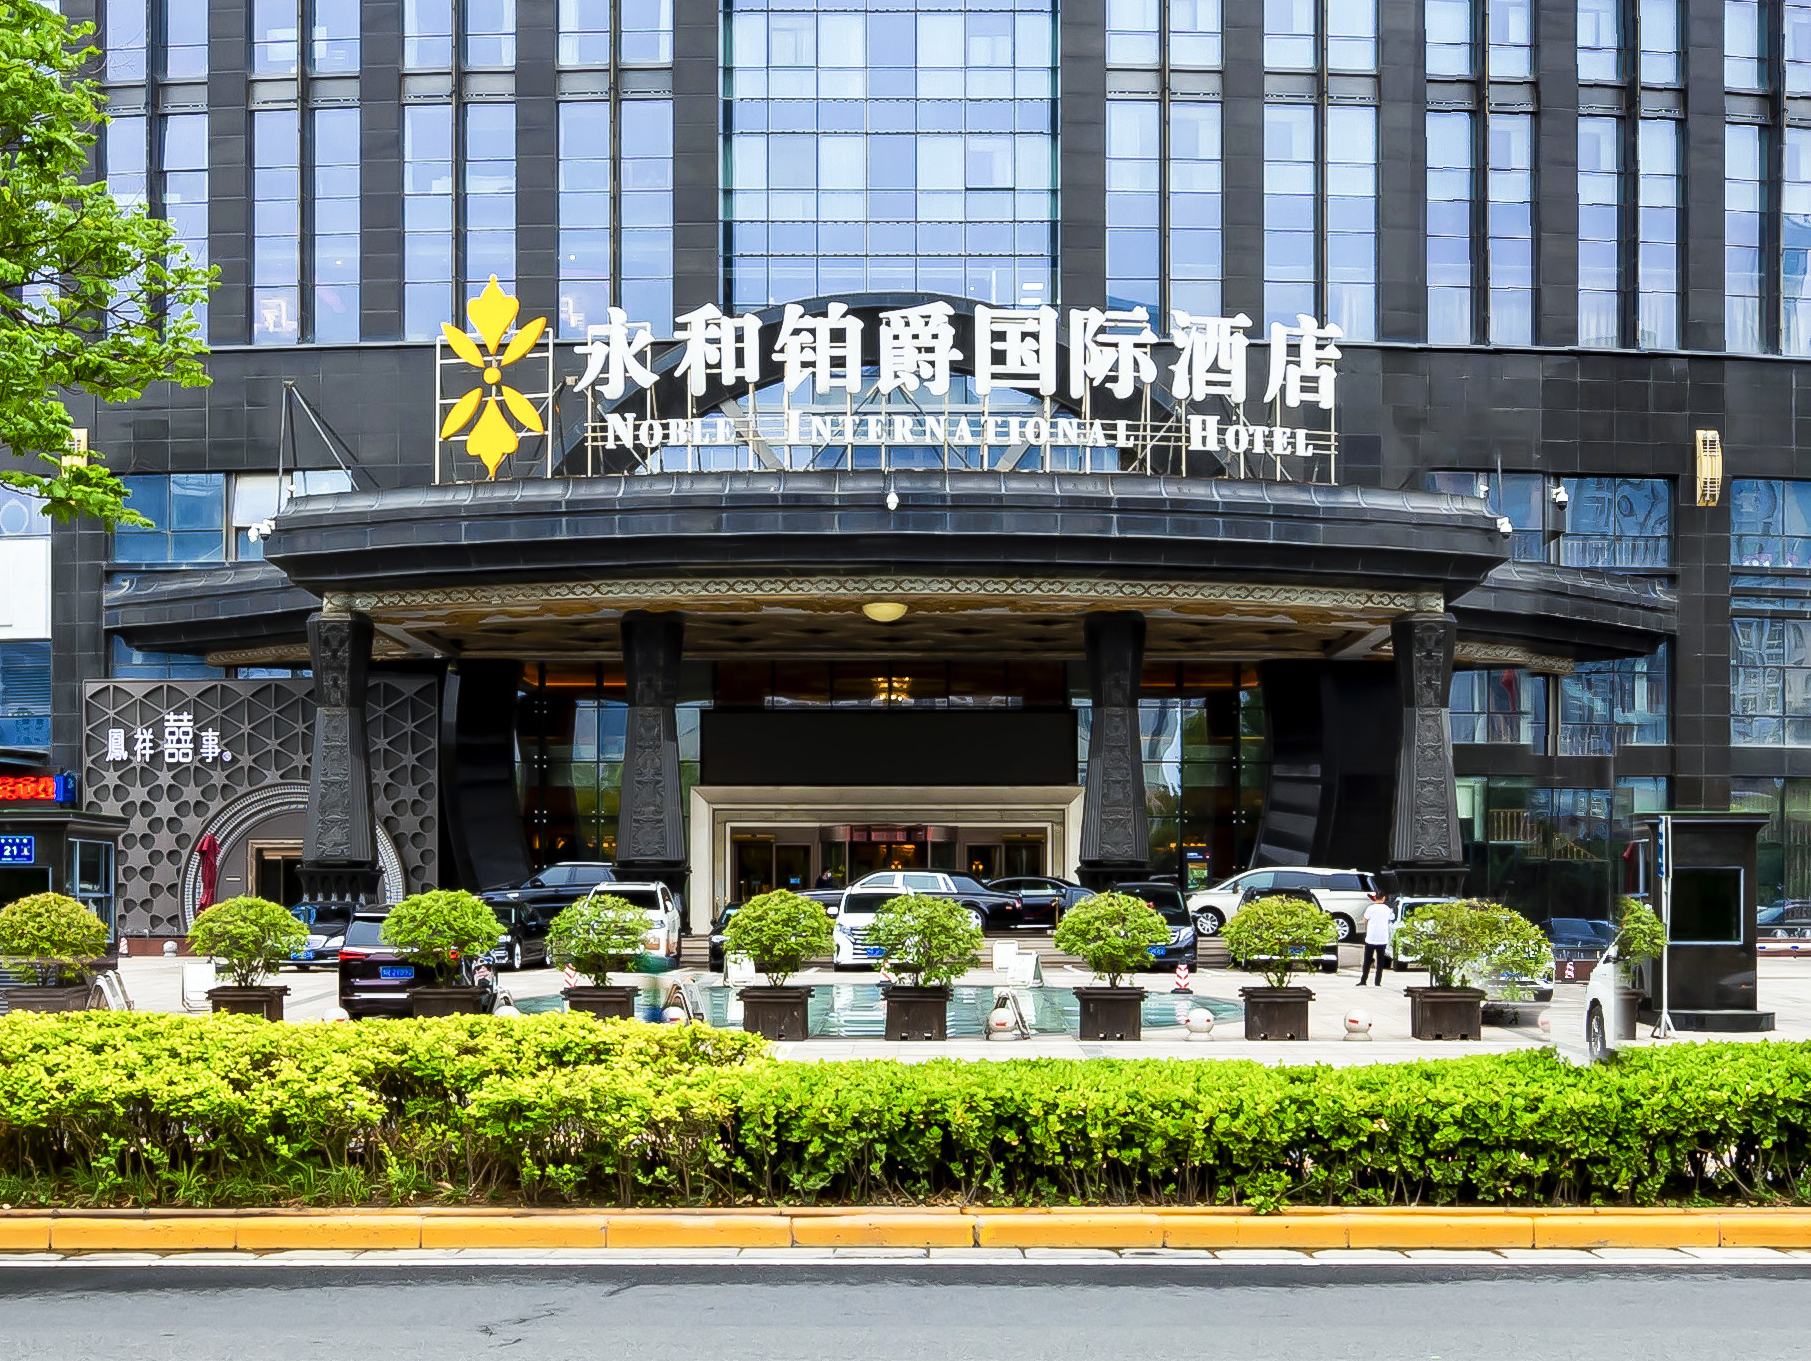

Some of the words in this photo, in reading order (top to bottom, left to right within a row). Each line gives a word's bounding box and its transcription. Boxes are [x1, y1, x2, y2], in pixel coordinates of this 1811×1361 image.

[572, 300, 1344, 410] 永和铂爵国际酒店
